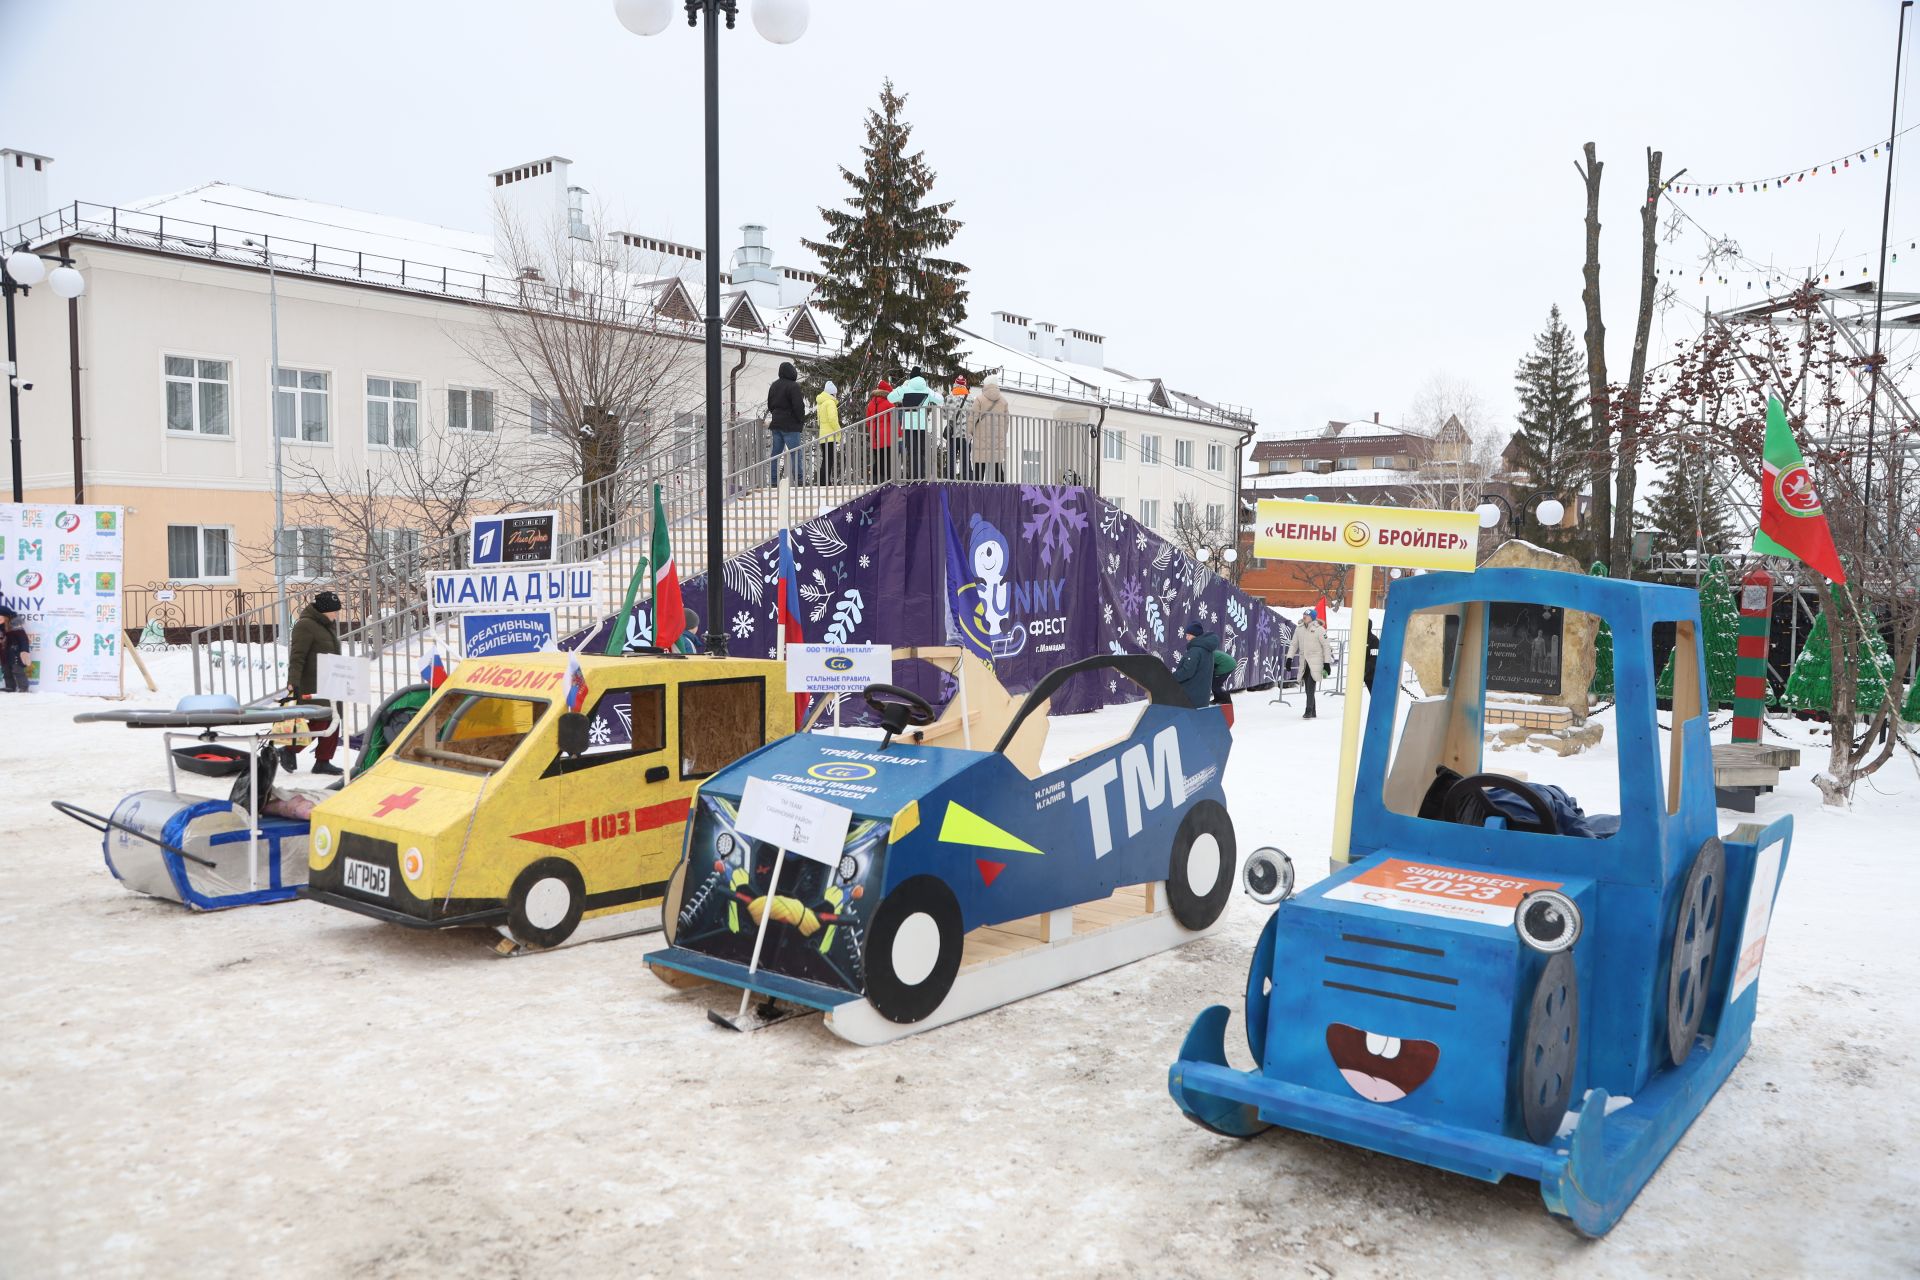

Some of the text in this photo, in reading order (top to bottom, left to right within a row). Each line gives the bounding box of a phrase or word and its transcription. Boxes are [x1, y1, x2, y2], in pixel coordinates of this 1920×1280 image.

[1265, 523, 1468, 550] «ЧЕЛНЫ БРОЙЛЕР»
[436, 570, 592, 604] МАМАДЫШ
[466, 619, 544, 652] КРЕАТИВНЫМ
[1029, 617, 1066, 636] ФЕСТ
[466, 665, 564, 691] АЙБОЛИТ
[771, 773, 878, 794] СТАЛЬНЫЕ ПРАВИЛА
[824, 788, 867, 800] УСПЕХА
[1034, 780, 1065, 800] М.ГАЛИЕВ
[1036, 790, 1066, 811] И.ГАЛИЕВ
[591, 811, 631, 842] 103
[347, 861, 386, 893] АГРЫЗ
[1396, 876, 1502, 900] 2023
[1402, 866, 1530, 890] SUNNYФЕСТ
